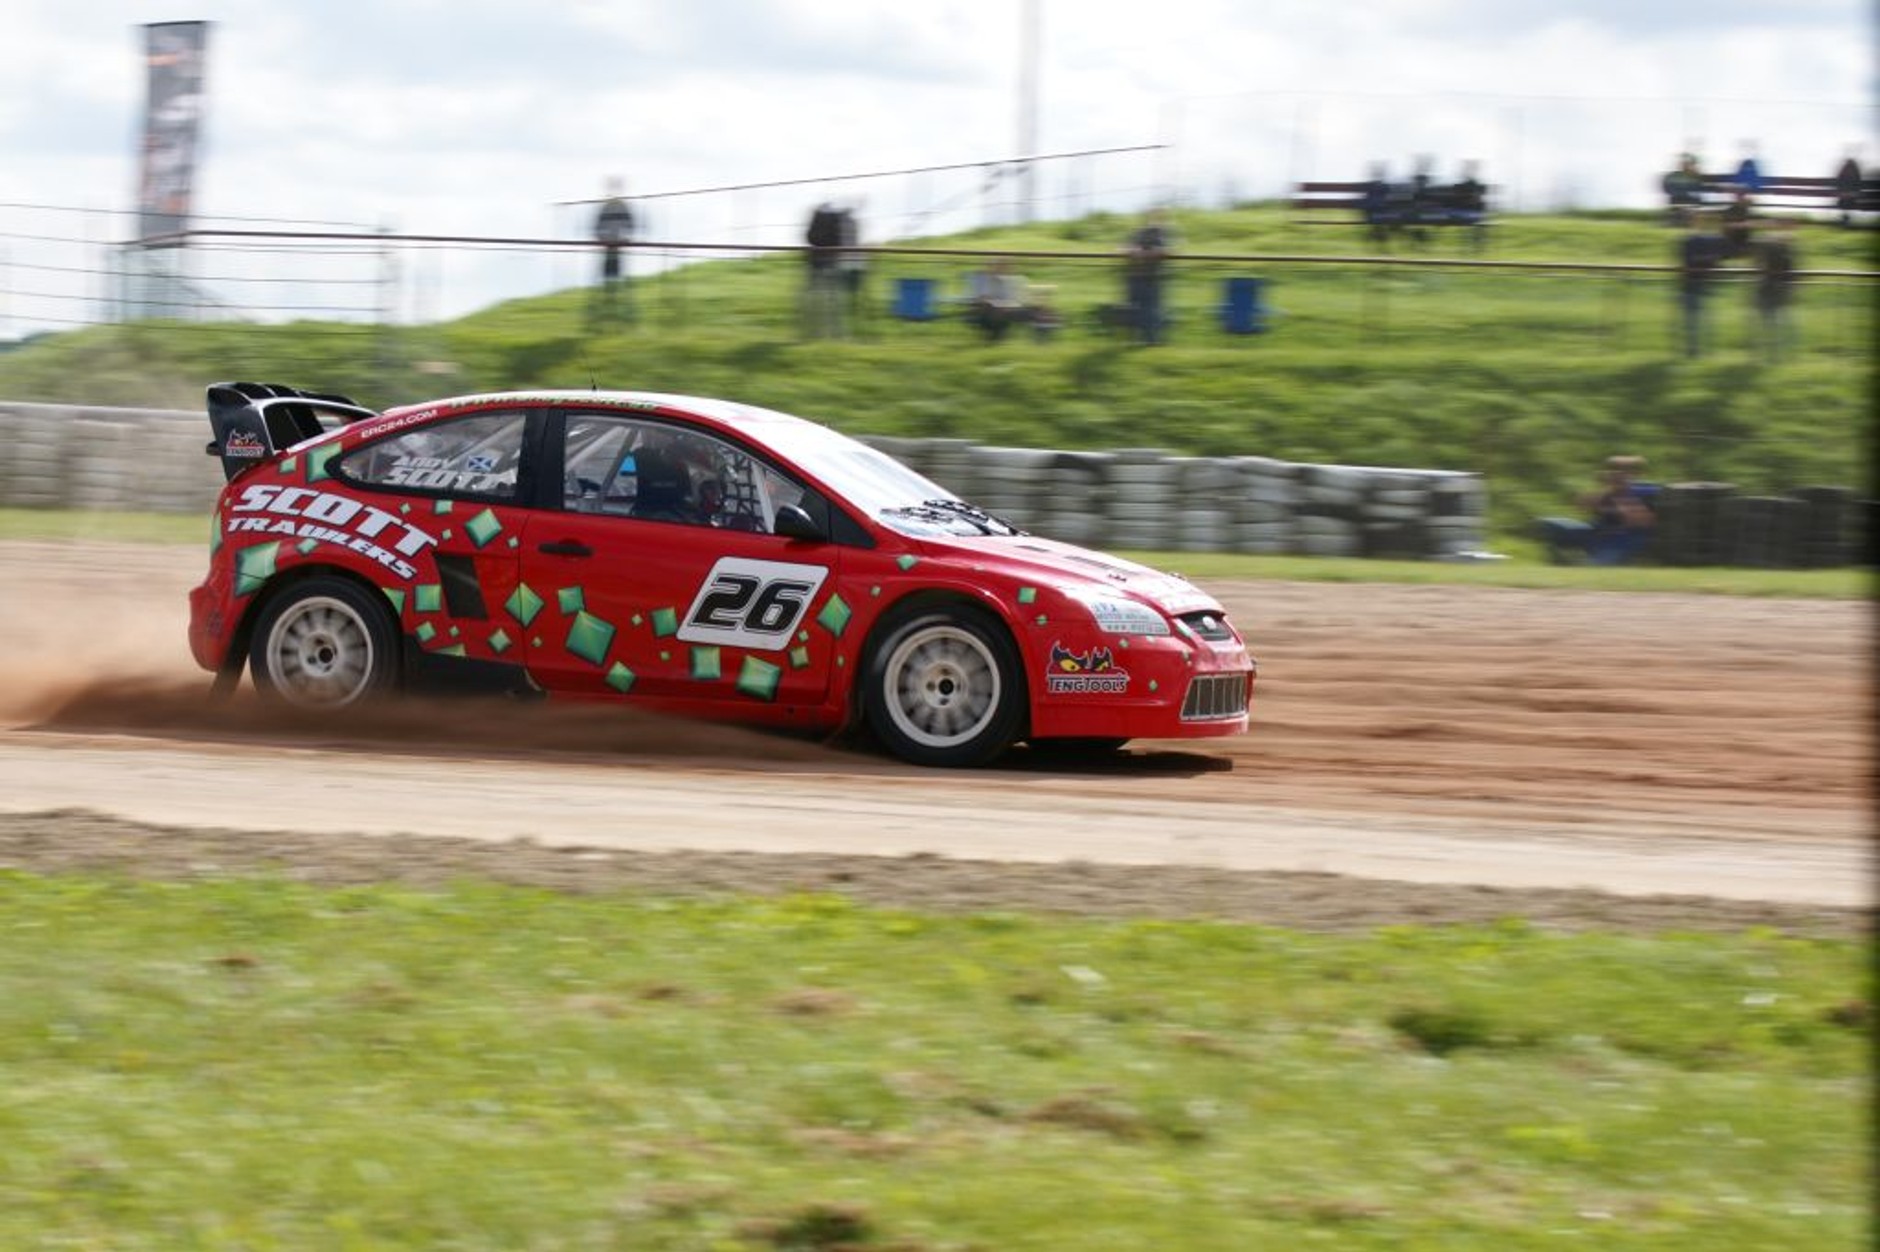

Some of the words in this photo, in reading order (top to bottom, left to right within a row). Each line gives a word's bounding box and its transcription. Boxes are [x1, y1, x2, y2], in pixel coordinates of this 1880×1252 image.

[228, 517, 417, 579] TRAWLERS
[233, 485, 438, 556] SCOTT
[687, 573, 816, 635] 26
